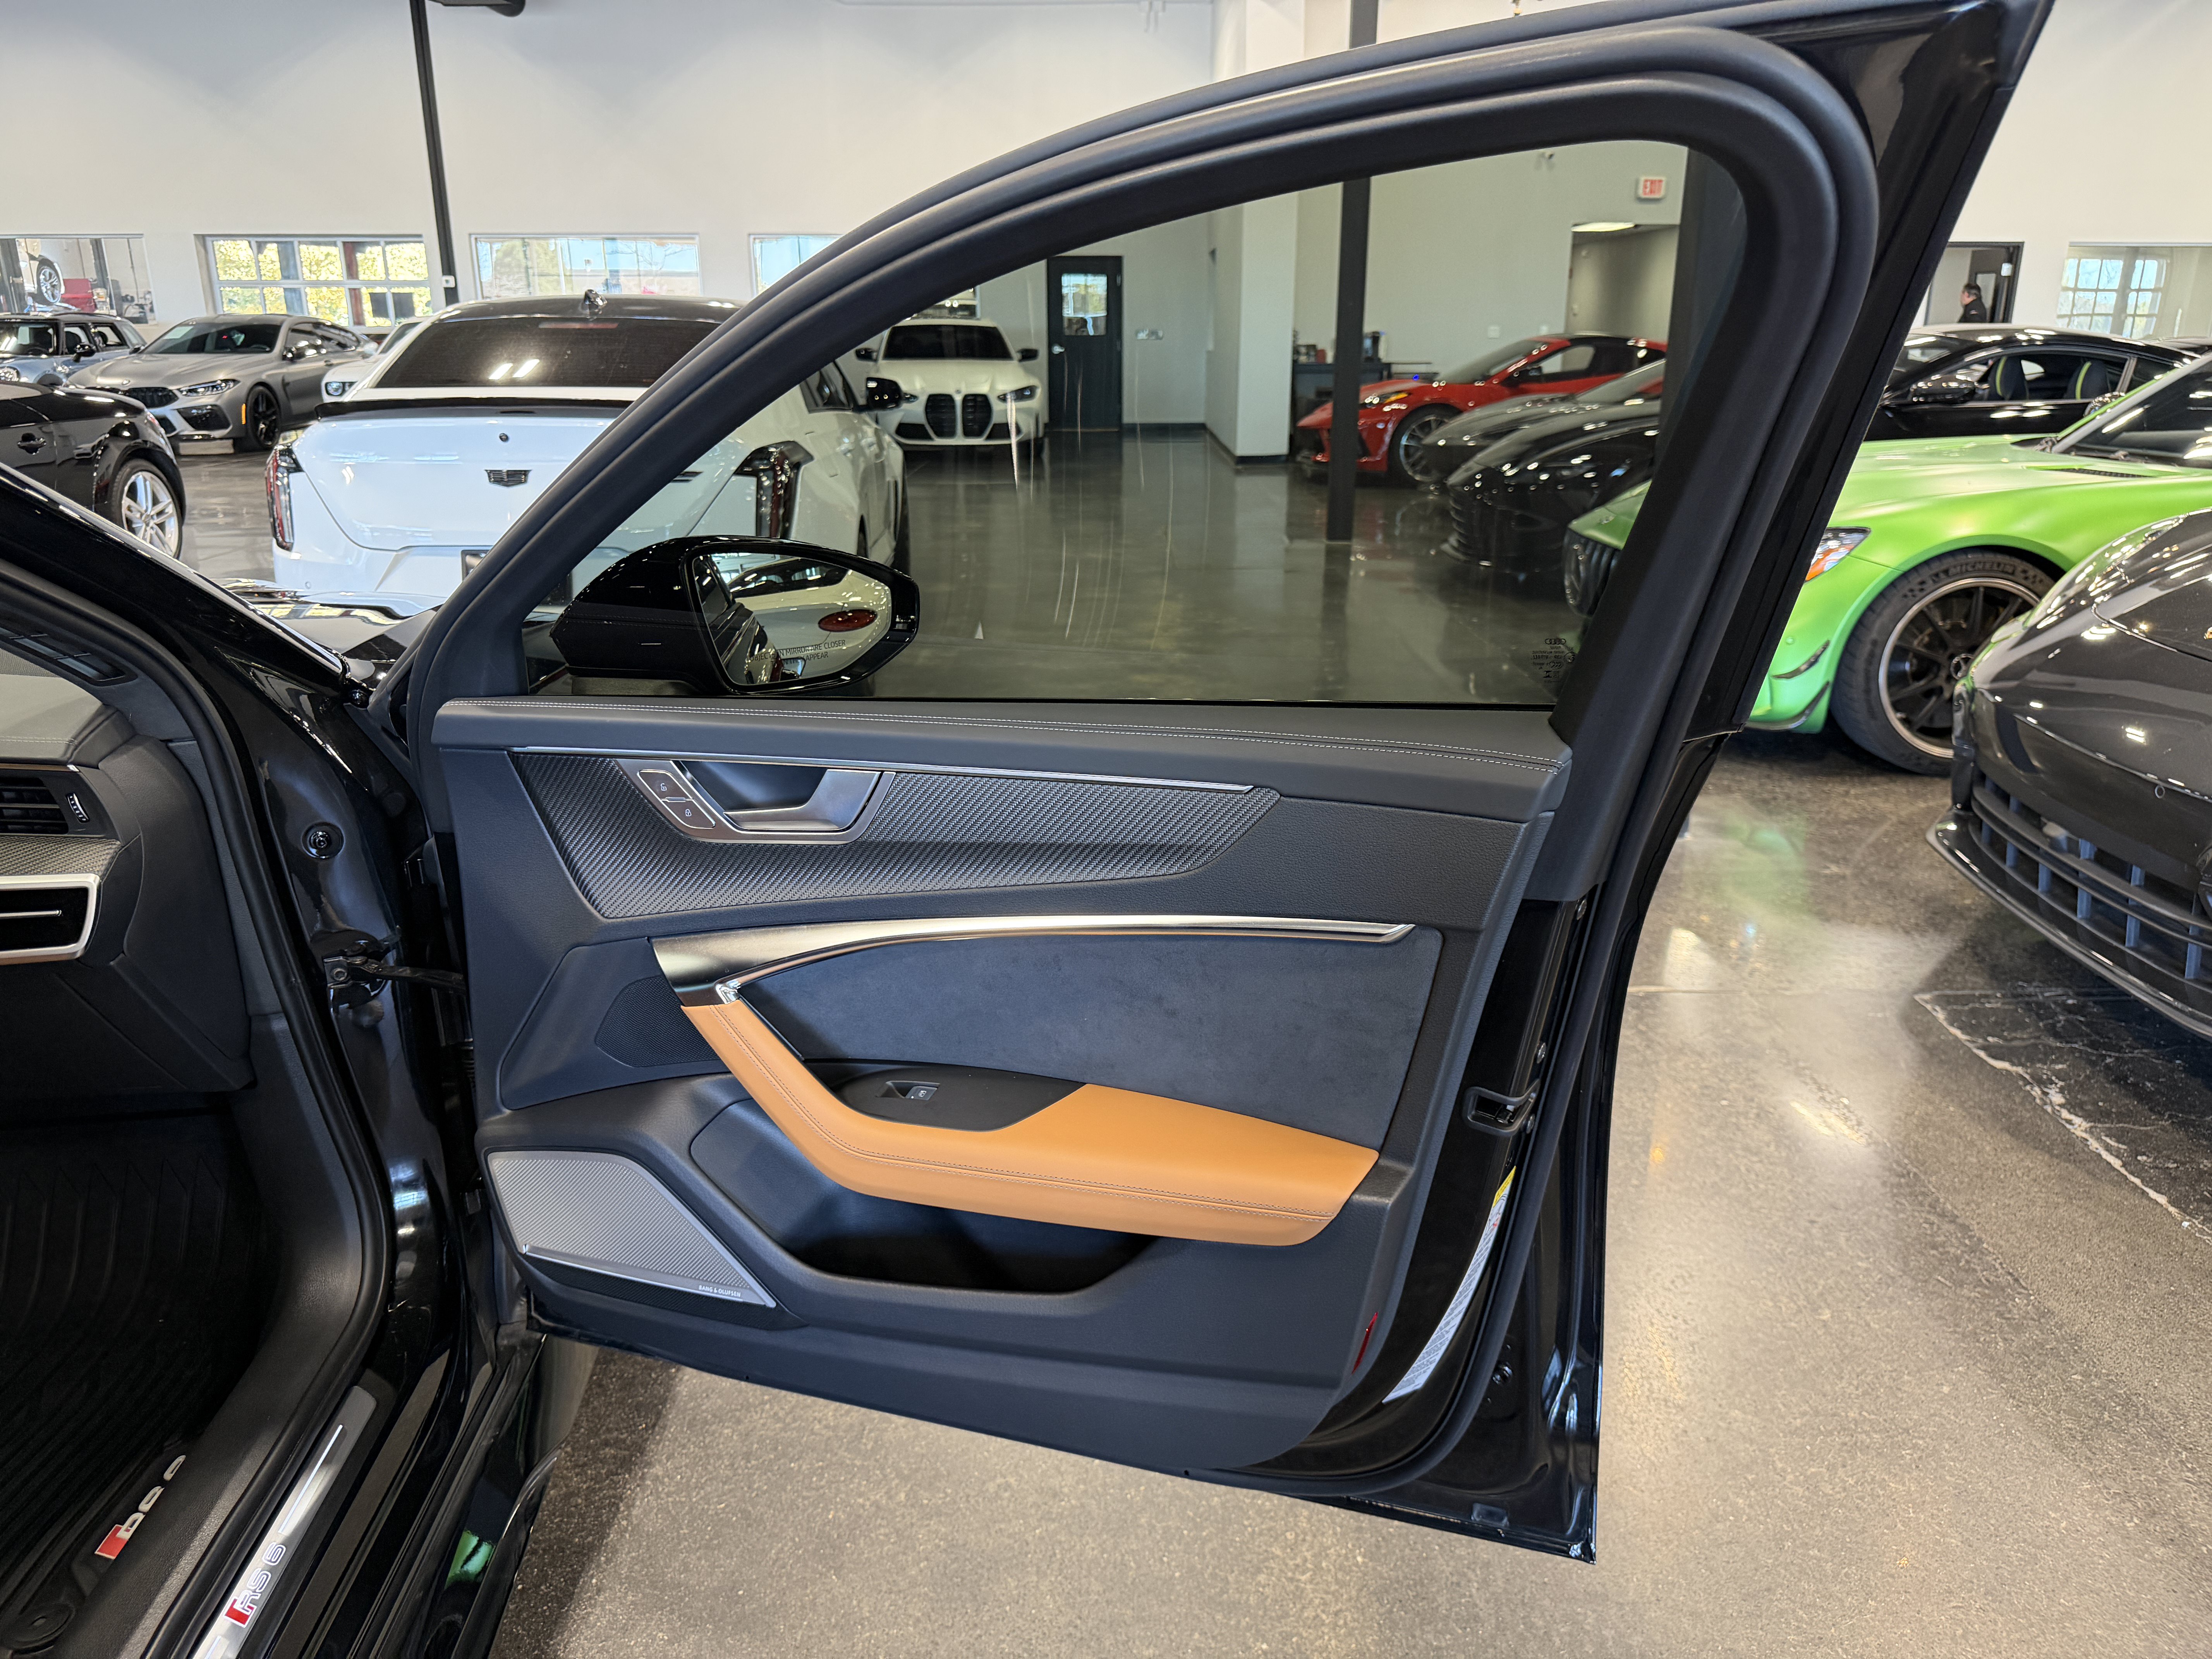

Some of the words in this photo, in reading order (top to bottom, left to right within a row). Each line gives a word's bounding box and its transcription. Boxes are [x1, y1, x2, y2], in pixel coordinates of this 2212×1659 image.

[1949, 562, 2015, 575] MICHELIN
[750, 653, 776, 661] OBJECTS
[786, 646, 809, 656] MIRROR
[824, 640, 845, 649] CLOSER
[806, 652, 828, 661] APPEAR
[718, 1288, 740, 1297] OLUFSEN
